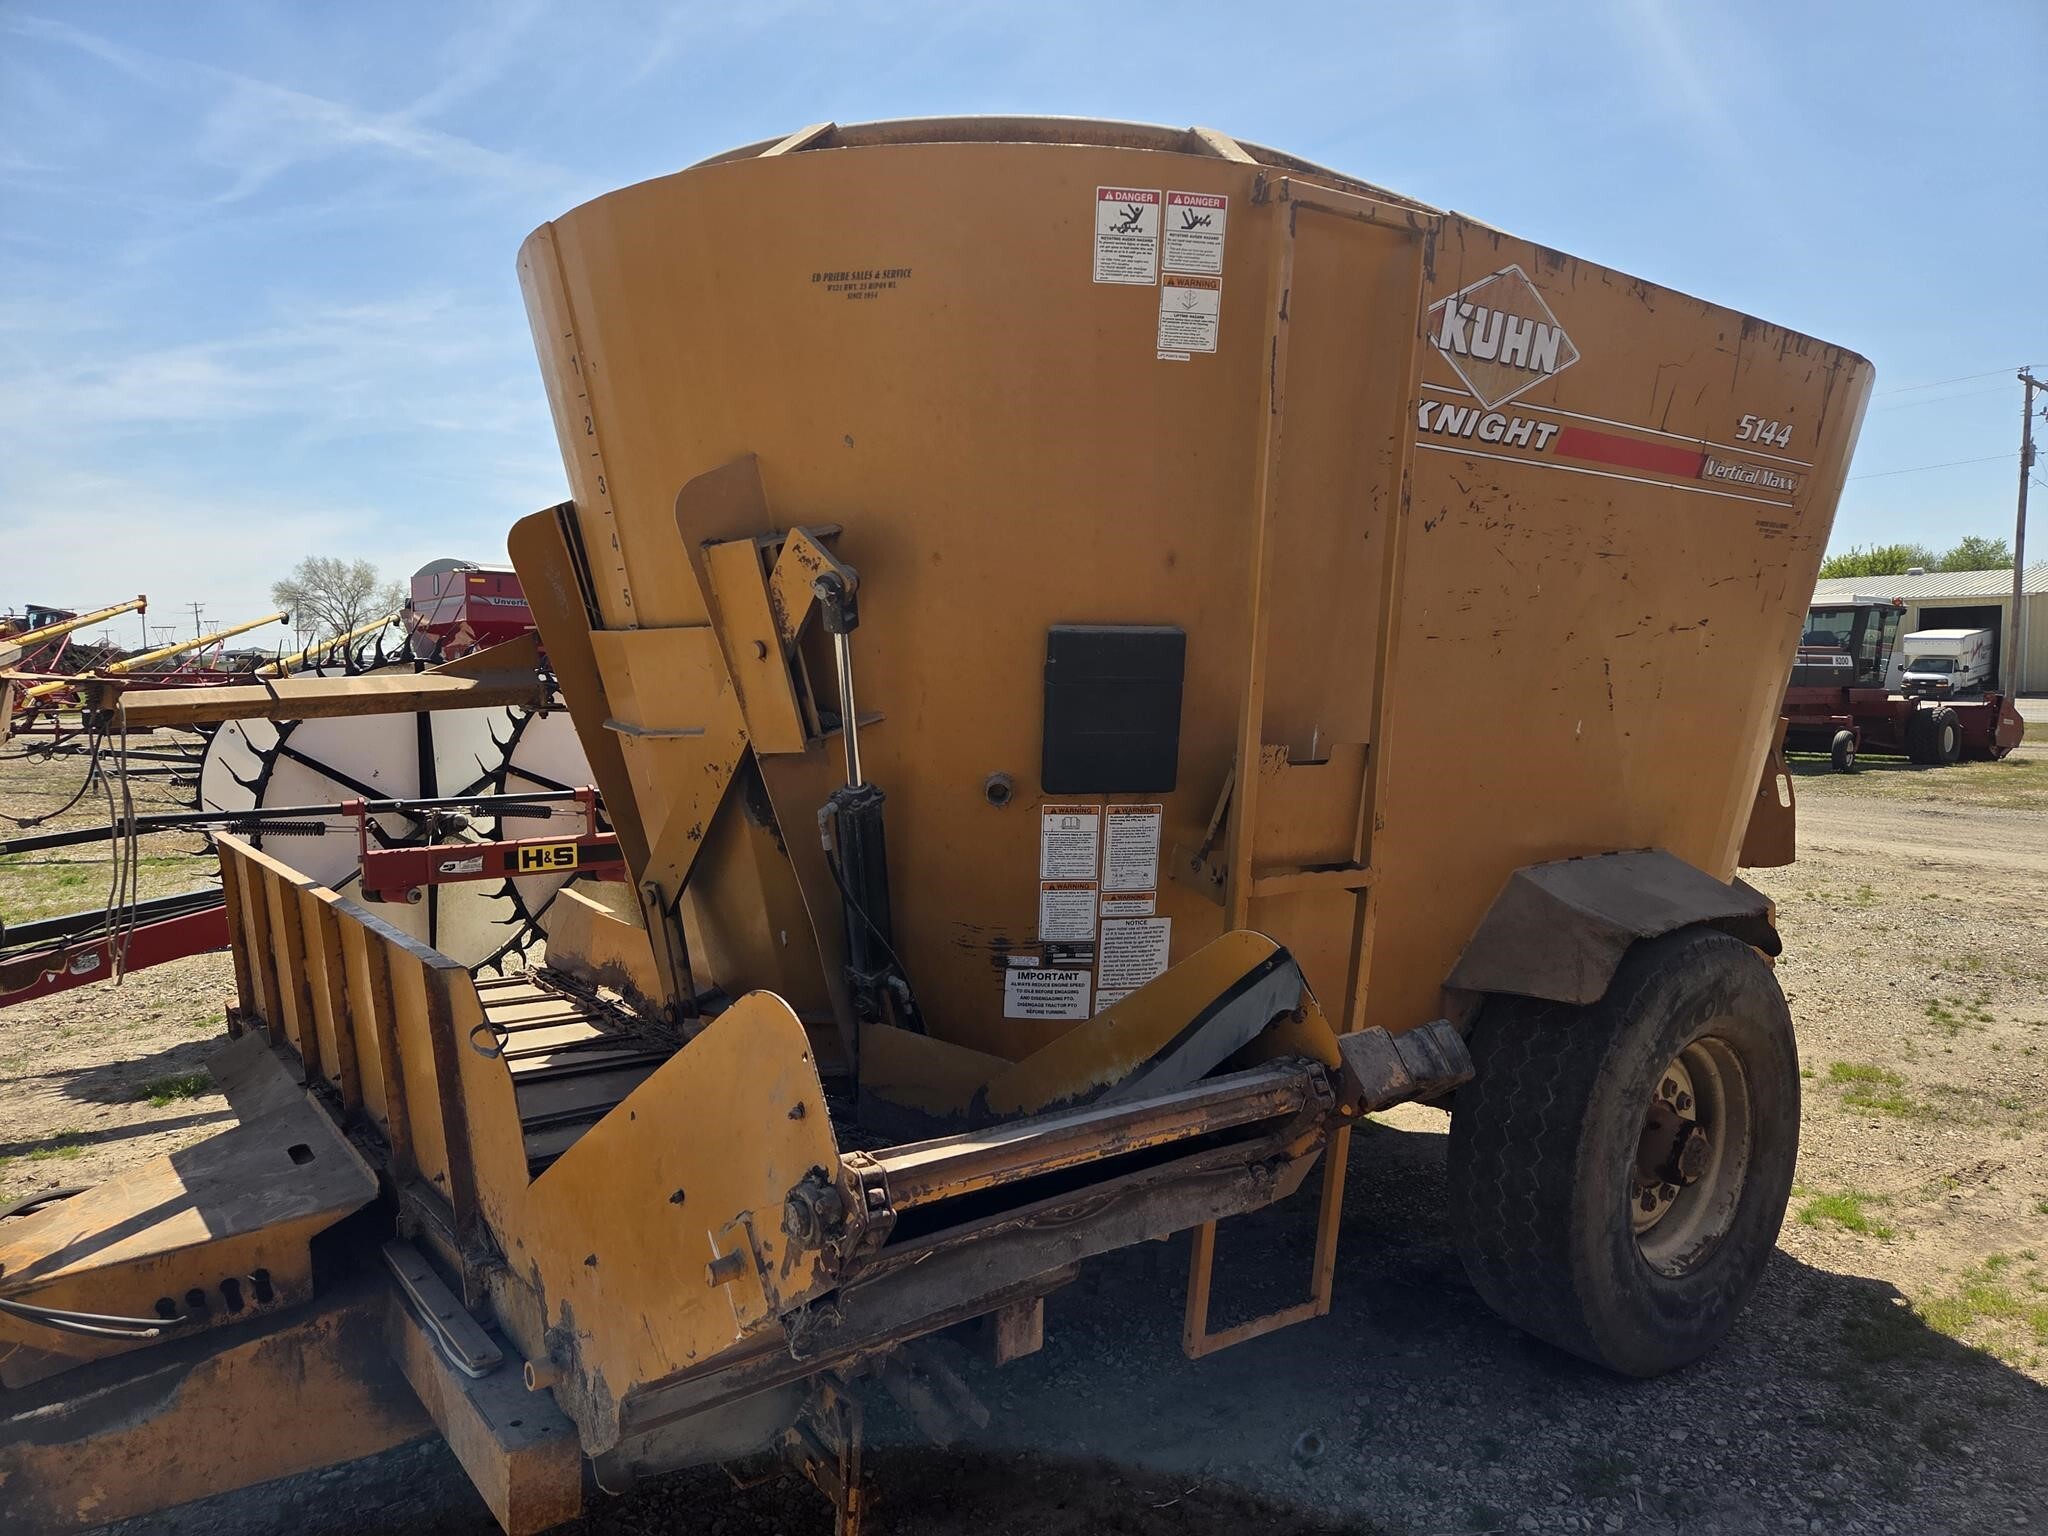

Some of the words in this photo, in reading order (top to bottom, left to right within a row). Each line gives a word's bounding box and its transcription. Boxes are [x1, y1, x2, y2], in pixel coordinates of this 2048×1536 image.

[1115, 192, 1153, 202] DANGER
[1184, 196, 1220, 207] DANGER
[812, 273, 821, 282] ED
[851, 270, 873, 280] SALES
[882, 268, 912, 278] SERVICE
[1176, 278, 1217, 289] WARNING
[1439, 298, 1562, 375] KUHN
[571, 354, 580, 376] 1
[584, 415, 594, 436] 2
[1417, 400, 1559, 452] KNIGHT
[1735, 414, 1794, 450] 5144
[1707, 455, 1758, 486] Vertical
[1759, 469, 1798, 492] Maxx
[597, 475, 607, 495] 3
[611, 532, 620, 552] 4
[623, 588, 631, 608] 5
[522, 846, 574, 868] H&S
[1018, 972, 1079, 980] IMPORTANT
